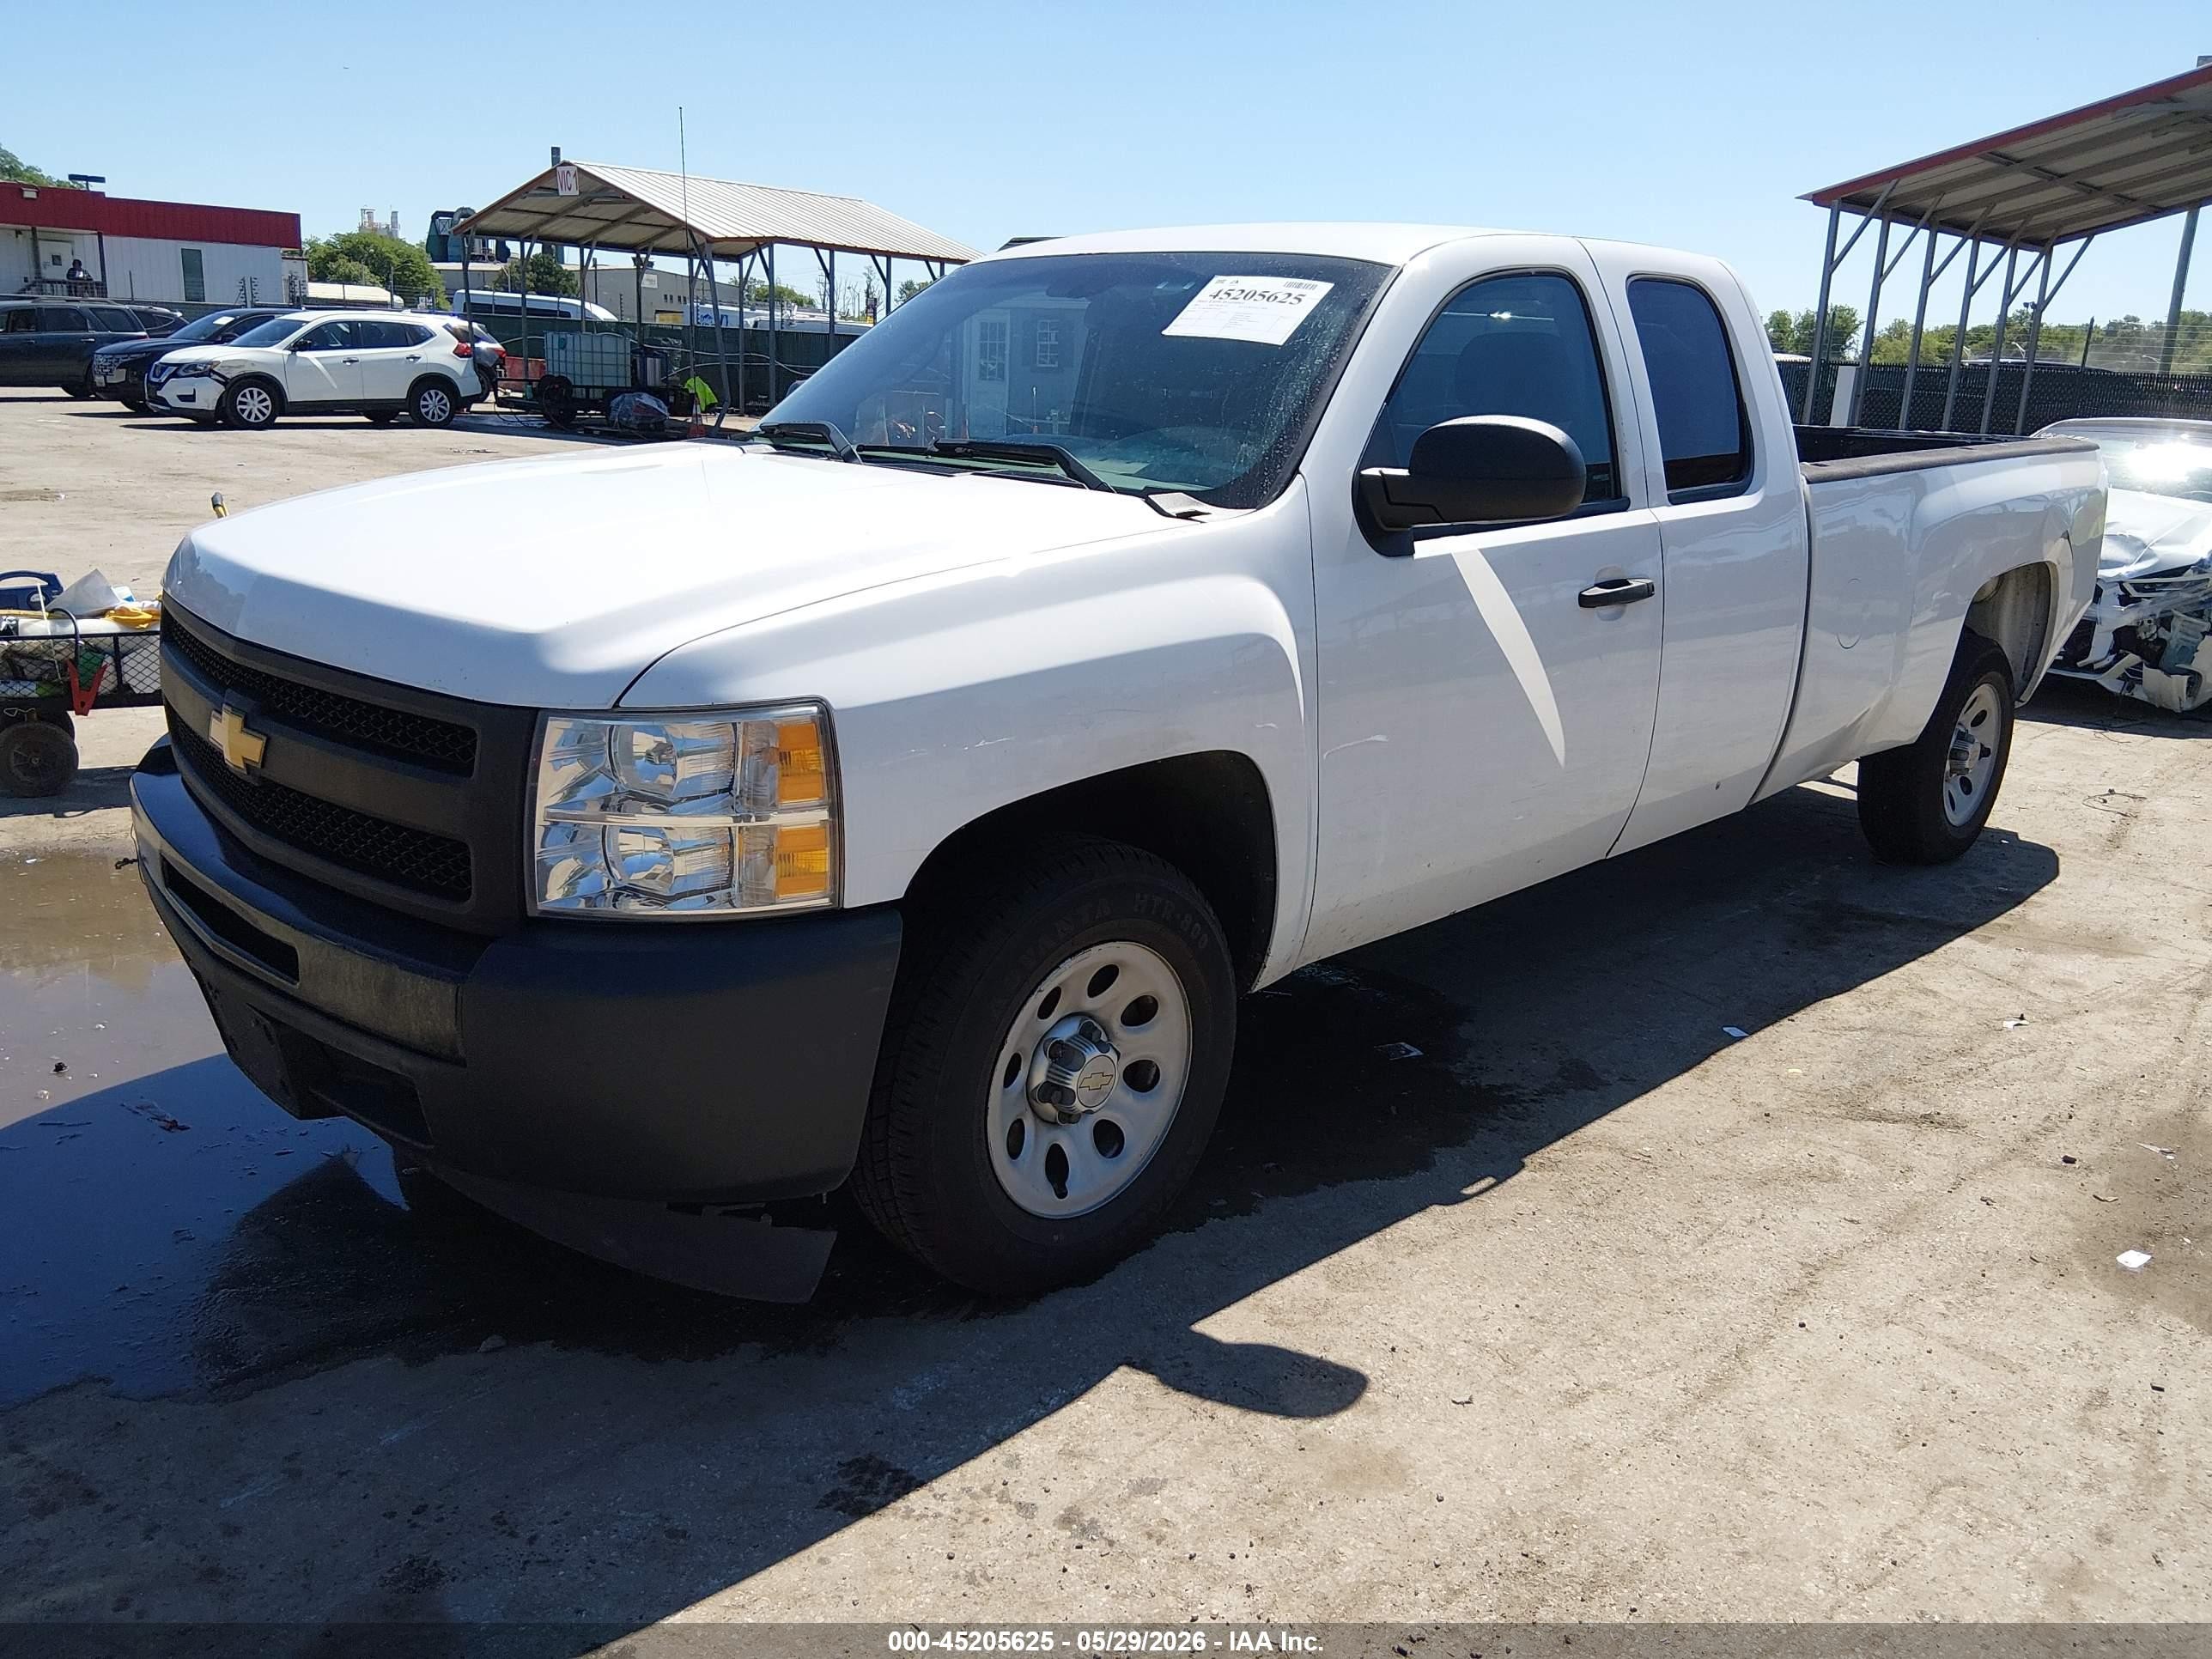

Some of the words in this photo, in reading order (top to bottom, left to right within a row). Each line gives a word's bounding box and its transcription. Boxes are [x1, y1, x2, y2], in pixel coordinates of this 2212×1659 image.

[558, 170, 572, 192] VIC
[573, 170, 578, 191] 1
[1209, 288, 1307, 306] 45205625
